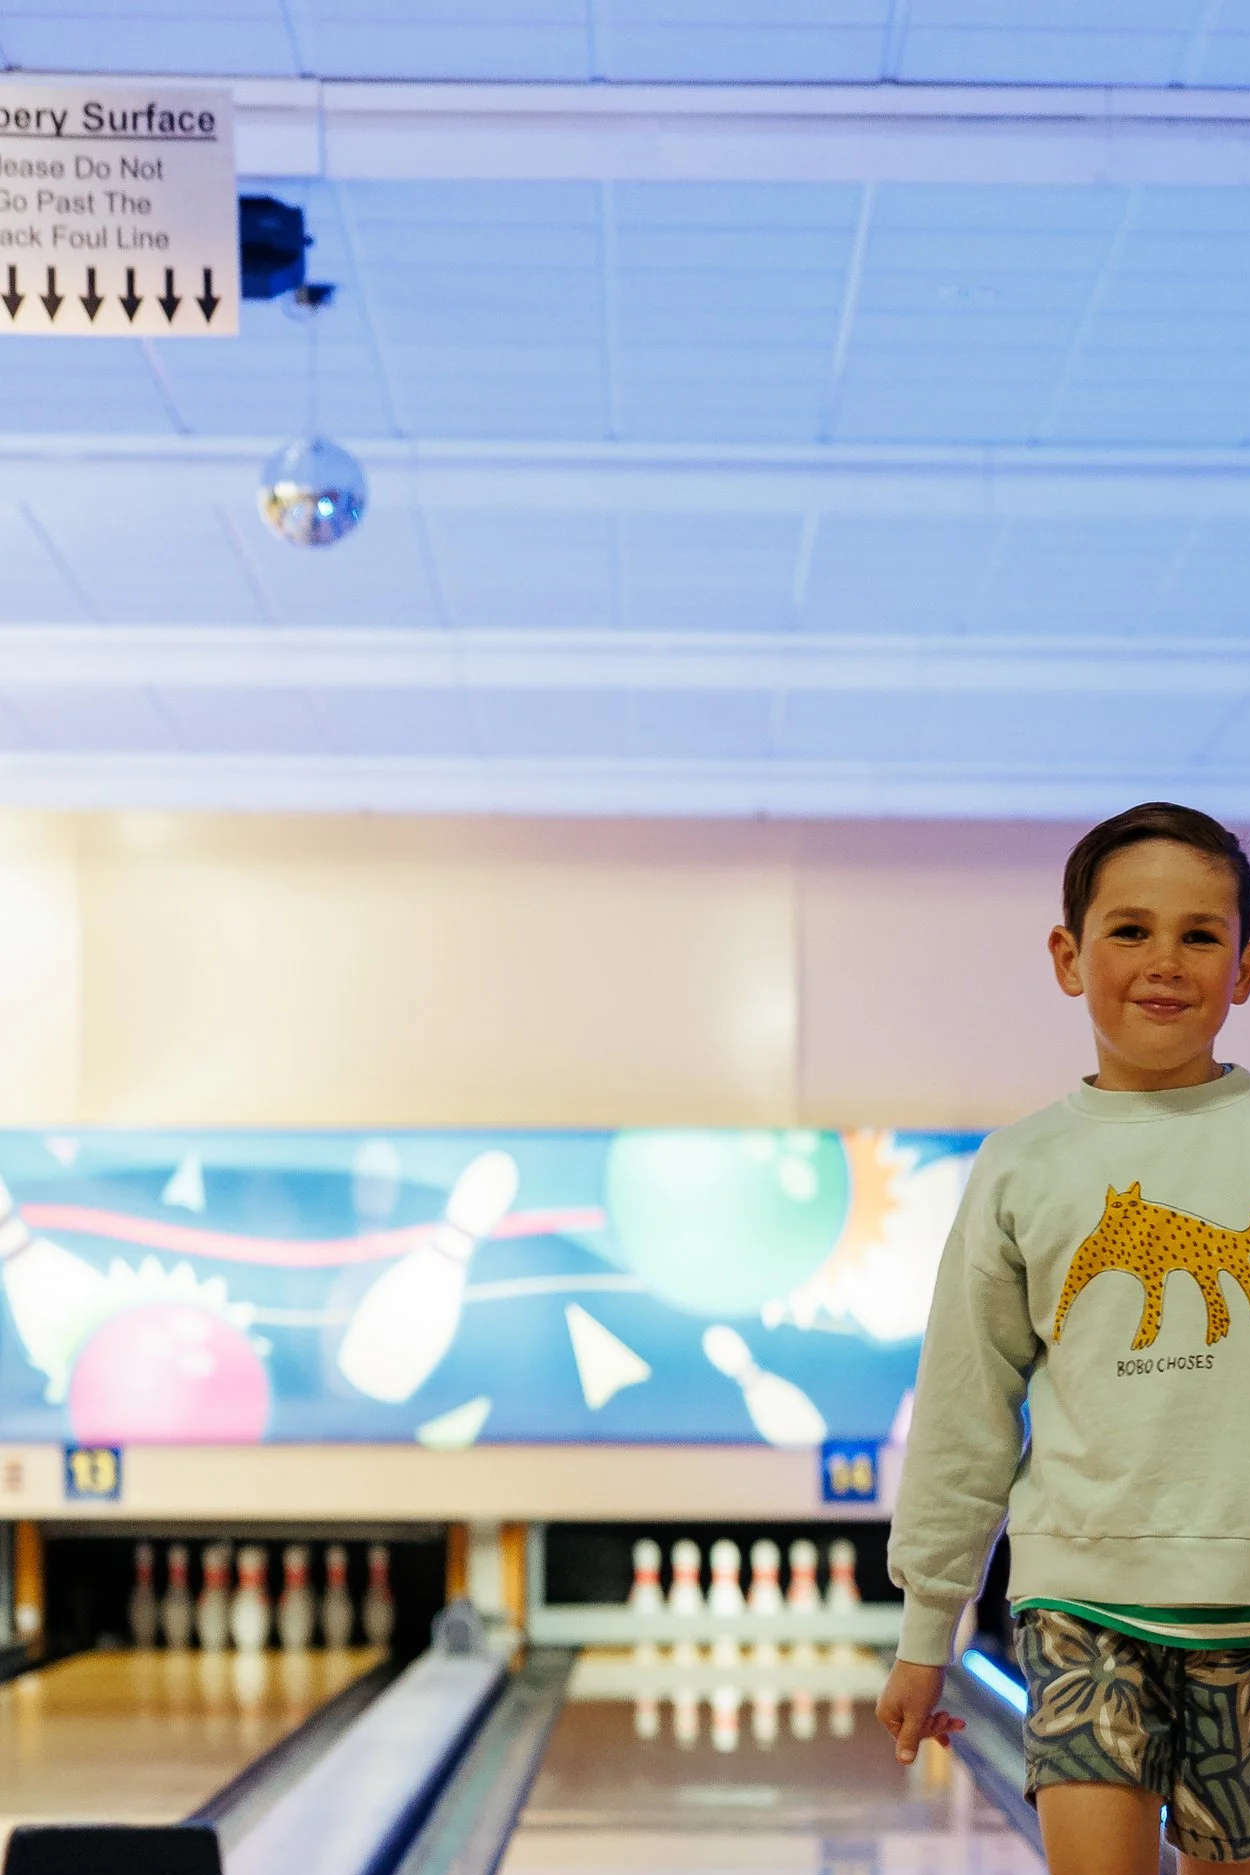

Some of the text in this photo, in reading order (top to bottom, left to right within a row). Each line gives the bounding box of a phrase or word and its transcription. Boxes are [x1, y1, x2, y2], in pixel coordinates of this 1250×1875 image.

[83, 101, 215, 134] Surface
[74, 155, 111, 180] Do
[120, 157, 164, 181] Not
[37, 189, 94, 215] Past
[104, 190, 151, 215] The
[52, 225, 107, 250] Foul
[117, 226, 170, 250] Line
[1116, 1354, 1214, 1377] BOBO CHOSES
